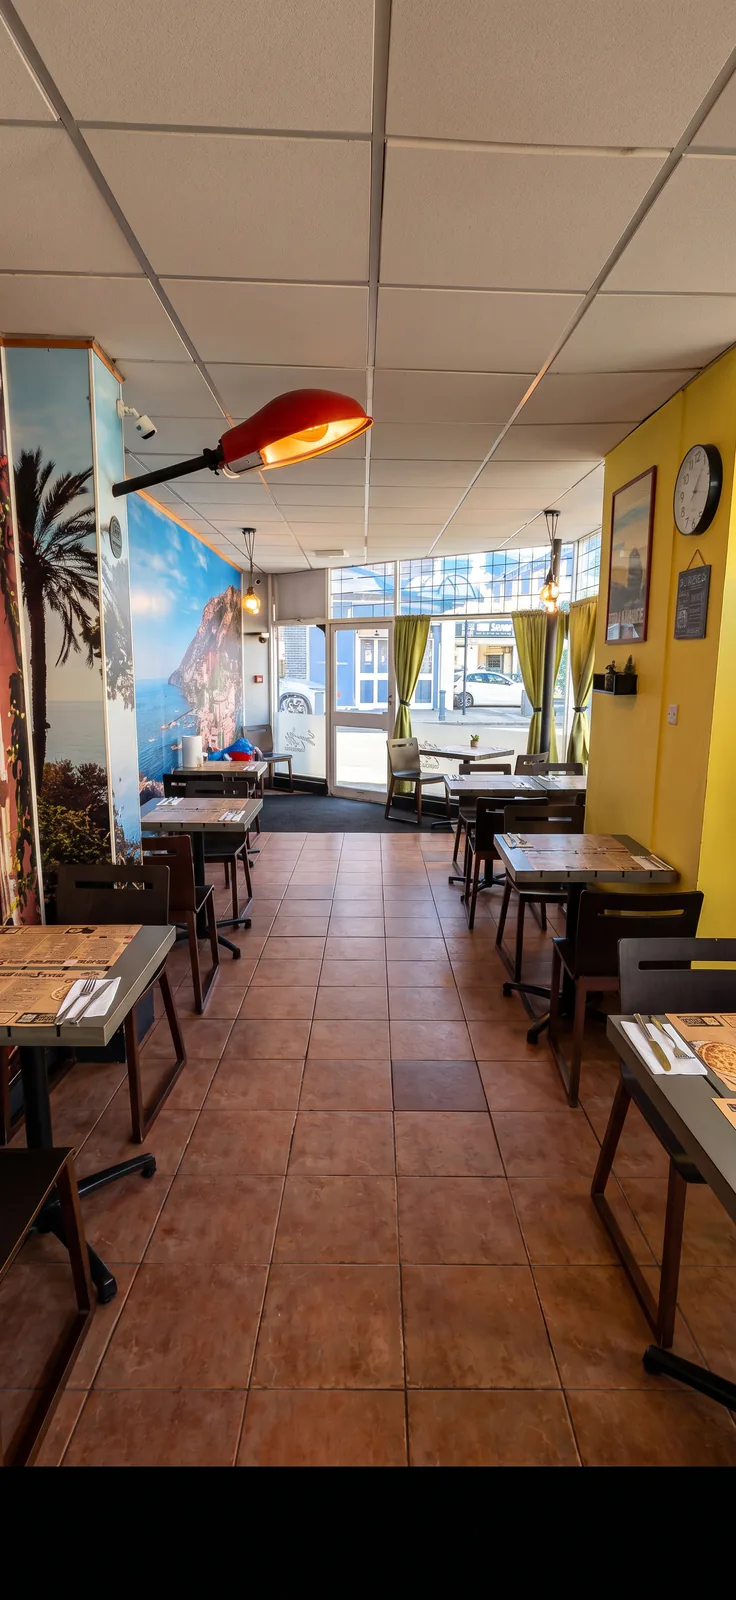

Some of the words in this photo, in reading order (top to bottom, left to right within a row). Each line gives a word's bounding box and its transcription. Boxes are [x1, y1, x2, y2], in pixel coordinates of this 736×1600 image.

[683, 473, 690, 485] 10
[680, 492, 685, 504] 9
[681, 506, 686, 518] 8
[685, 517, 690, 530] 7
